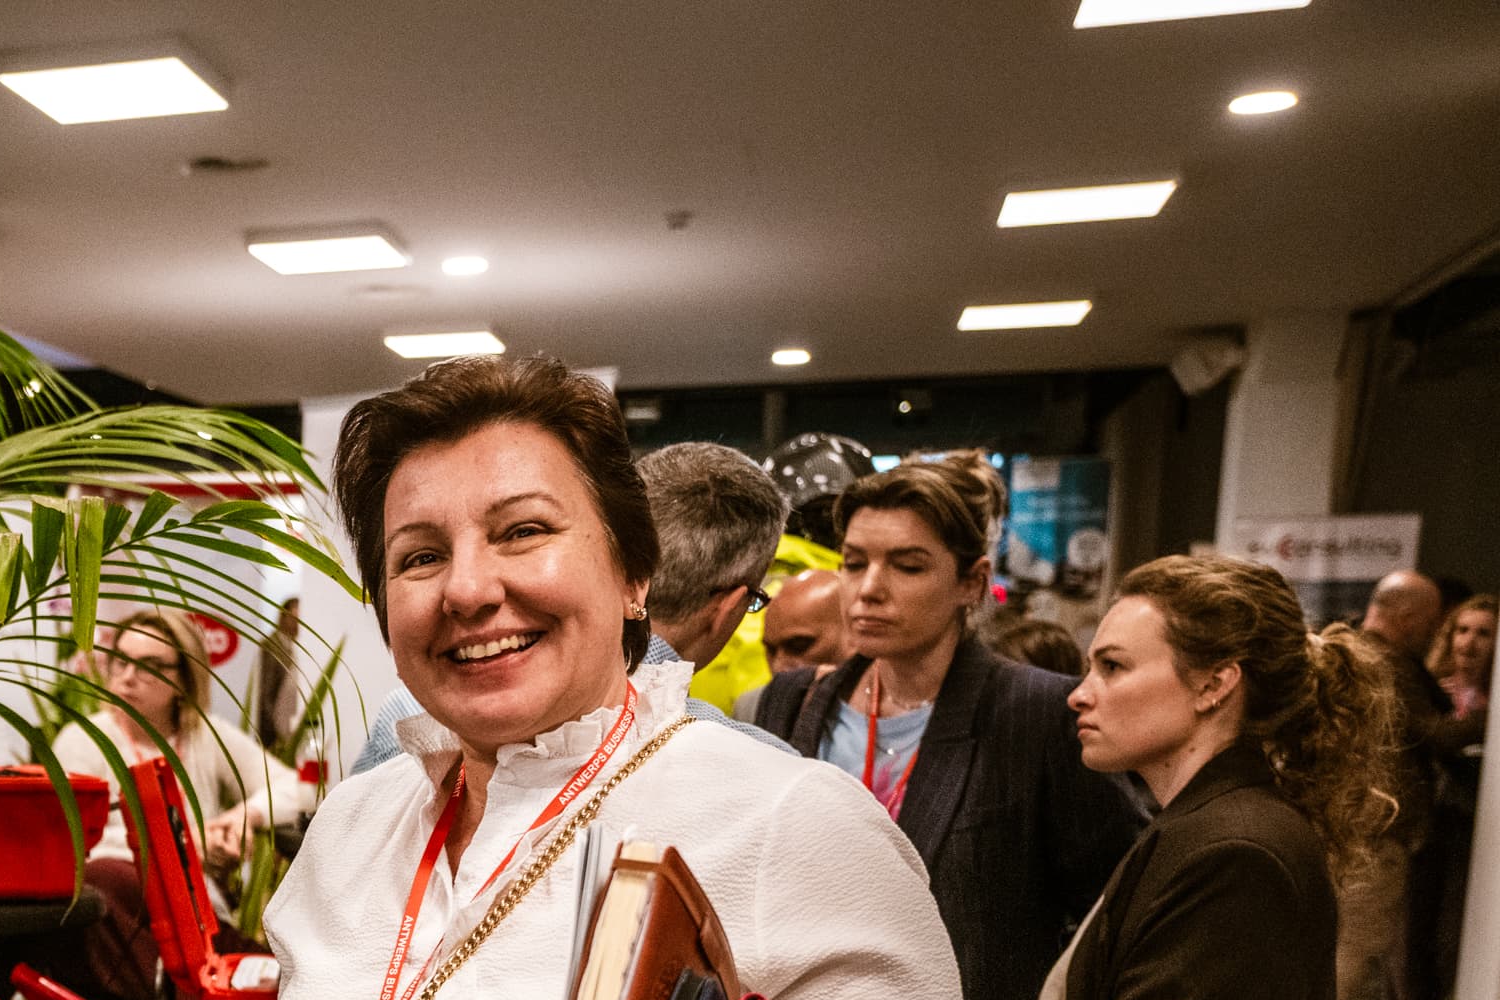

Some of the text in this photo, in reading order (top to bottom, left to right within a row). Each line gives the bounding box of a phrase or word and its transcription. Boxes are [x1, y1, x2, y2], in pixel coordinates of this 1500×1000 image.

[558, 711, 634, 805] ANTWERPS BUSINESS
[389, 915, 414, 976] ANTWERPS
